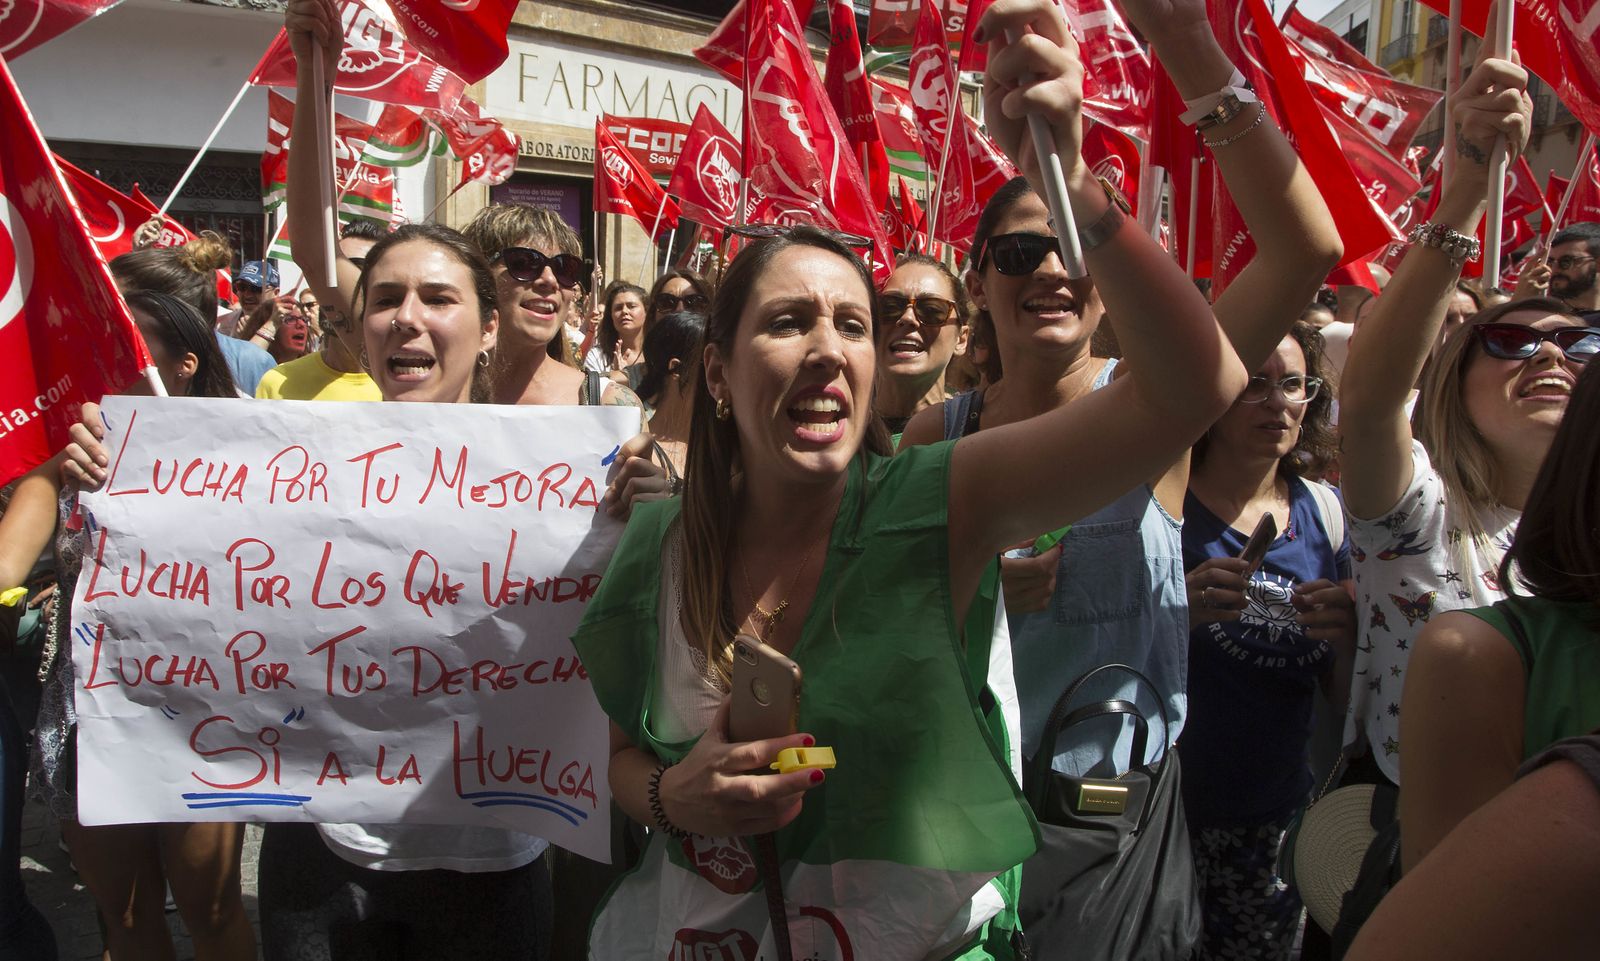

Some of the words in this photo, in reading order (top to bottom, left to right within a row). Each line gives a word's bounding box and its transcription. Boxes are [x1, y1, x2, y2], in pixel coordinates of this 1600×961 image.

[266, 445, 329, 508] POR
[346, 442, 404, 508] TU
[226, 538, 292, 611] POR
[312, 541, 387, 609] LOS
[403, 549, 466, 618] QUE
[226, 630, 296, 695] POR
[307, 625, 387, 697] TUS
[1253, 654, 1287, 669] AND
[1296, 638, 1330, 668] VIBE
[316, 752, 348, 786] A
[376, 744, 423, 786] LA
[452, 720, 598, 808] HUELGA
